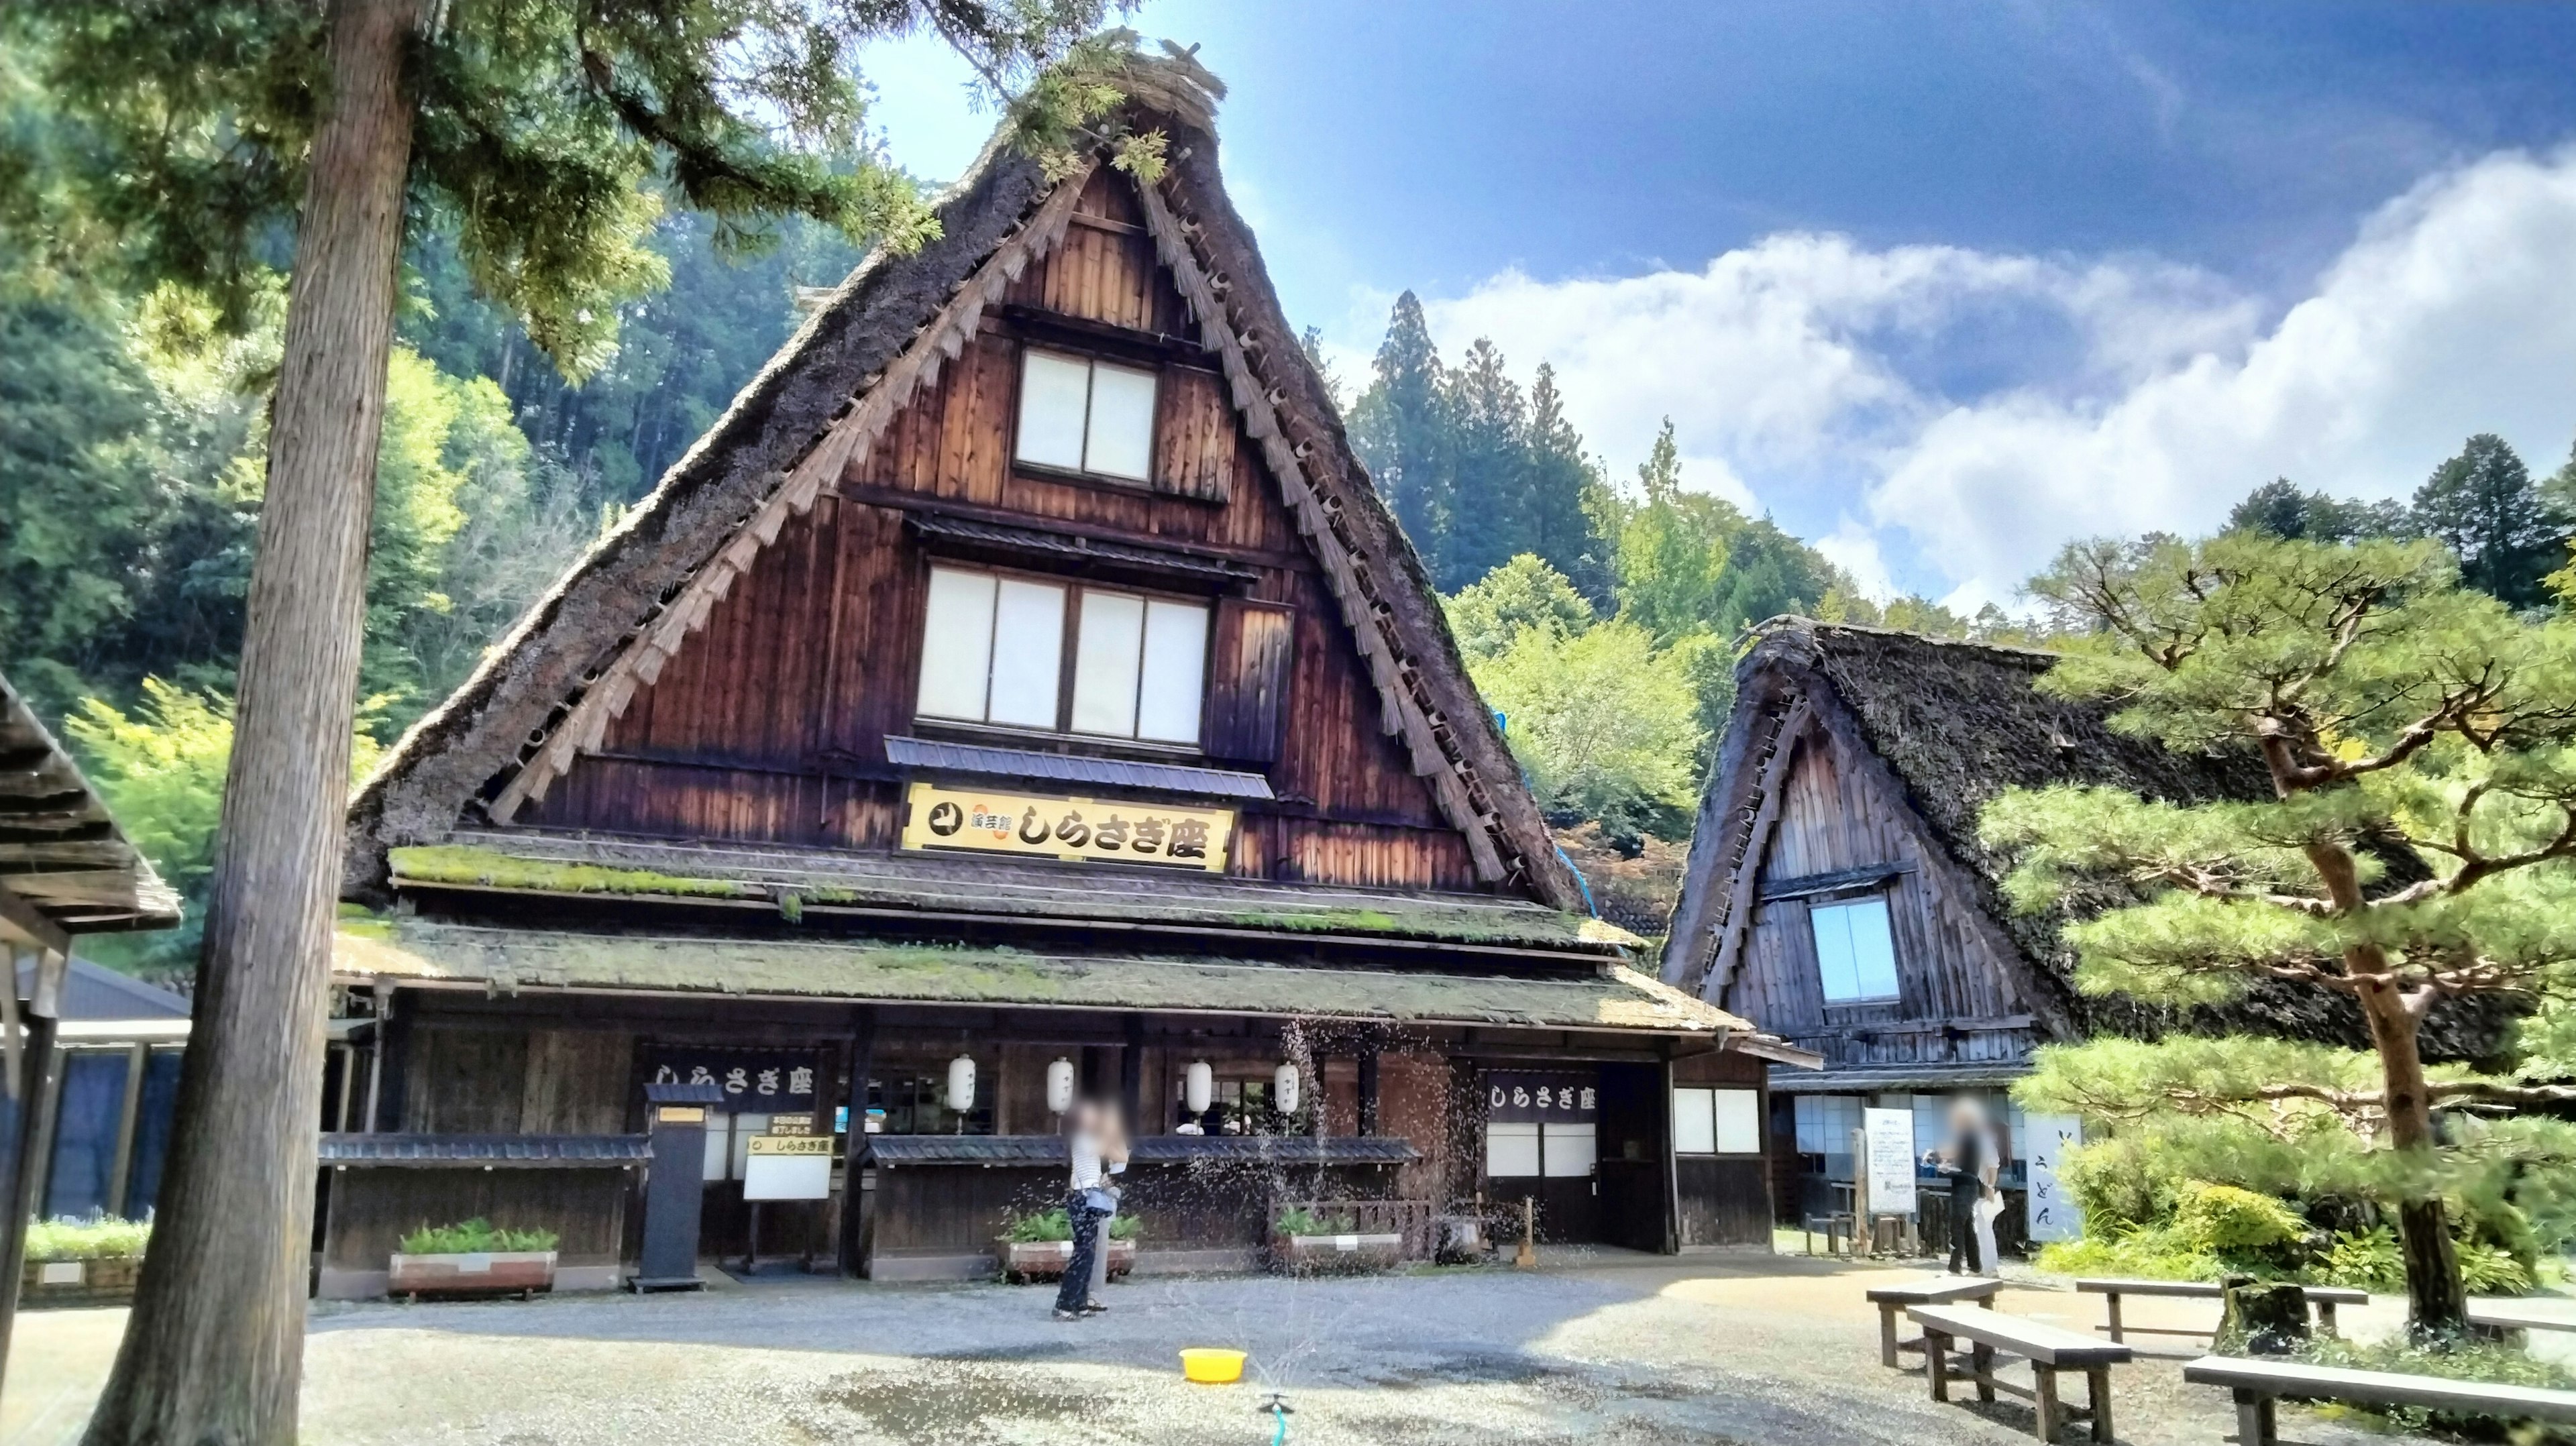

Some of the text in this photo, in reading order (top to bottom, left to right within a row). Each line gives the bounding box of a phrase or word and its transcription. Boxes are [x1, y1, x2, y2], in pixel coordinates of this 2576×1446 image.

[1018, 805, 1210, 860] しらさぎ座
[656, 1064, 812, 1095] しらさぎ座
[1491, 1085, 1596, 1110] しらさぎ座
[776, 1140, 829, 1152] しらさぎ座
[2035, 1154, 2054, 1225] うどん
